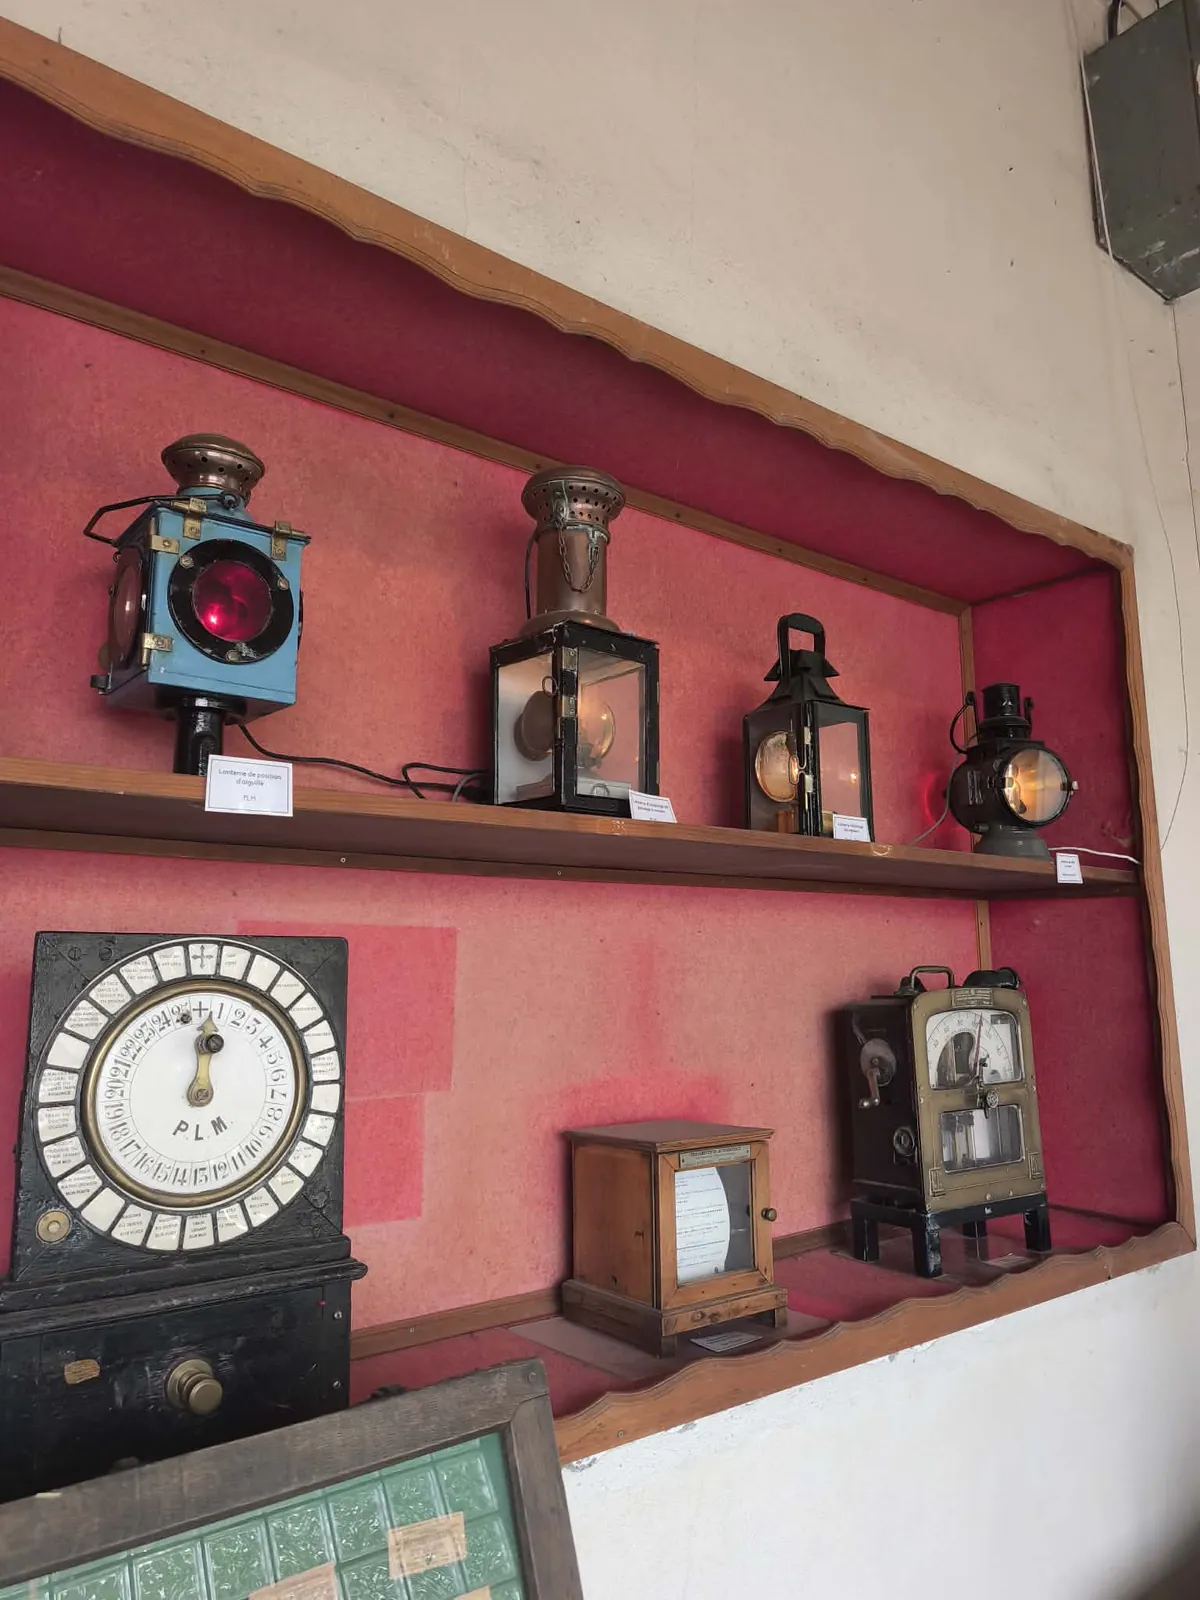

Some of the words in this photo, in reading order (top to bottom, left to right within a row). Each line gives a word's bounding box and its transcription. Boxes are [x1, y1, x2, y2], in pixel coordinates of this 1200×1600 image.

[217, 1002, 224, 1020] 1
[231, 1008, 246, 1027] 2
[151, 1011, 172, 1031] 24
[246, 1018, 262, 1035] 3
[133, 1022, 156, 1042] 23
[120, 1038, 143, 1061] 22
[259, 1035, 274, 1049] 4
[267, 1050, 284, 1065] 5
[110, 1058, 132, 1078] 21
[271, 1068, 288, 1082] 6
[104, 1078, 125, 1099] 20
[270, 1088, 287, 1102] 7
[104, 1103, 125, 1120] 19
[267, 1107, 284, 1121] 8
[108, 1122, 129, 1141] 18
[259, 1125, 274, 1139] 9
[118, 1140, 142, 1158] 17
[244, 1139, 262, 1159] 10
[133, 1153, 153, 1175] 16
[212, 1162, 230, 1180] 12
[230, 1154, 246, 1171] 11
[152, 1161, 171, 1183] 15
[172, 1167, 187, 1187] 14
[193, 1168, 209, 1186] 13
